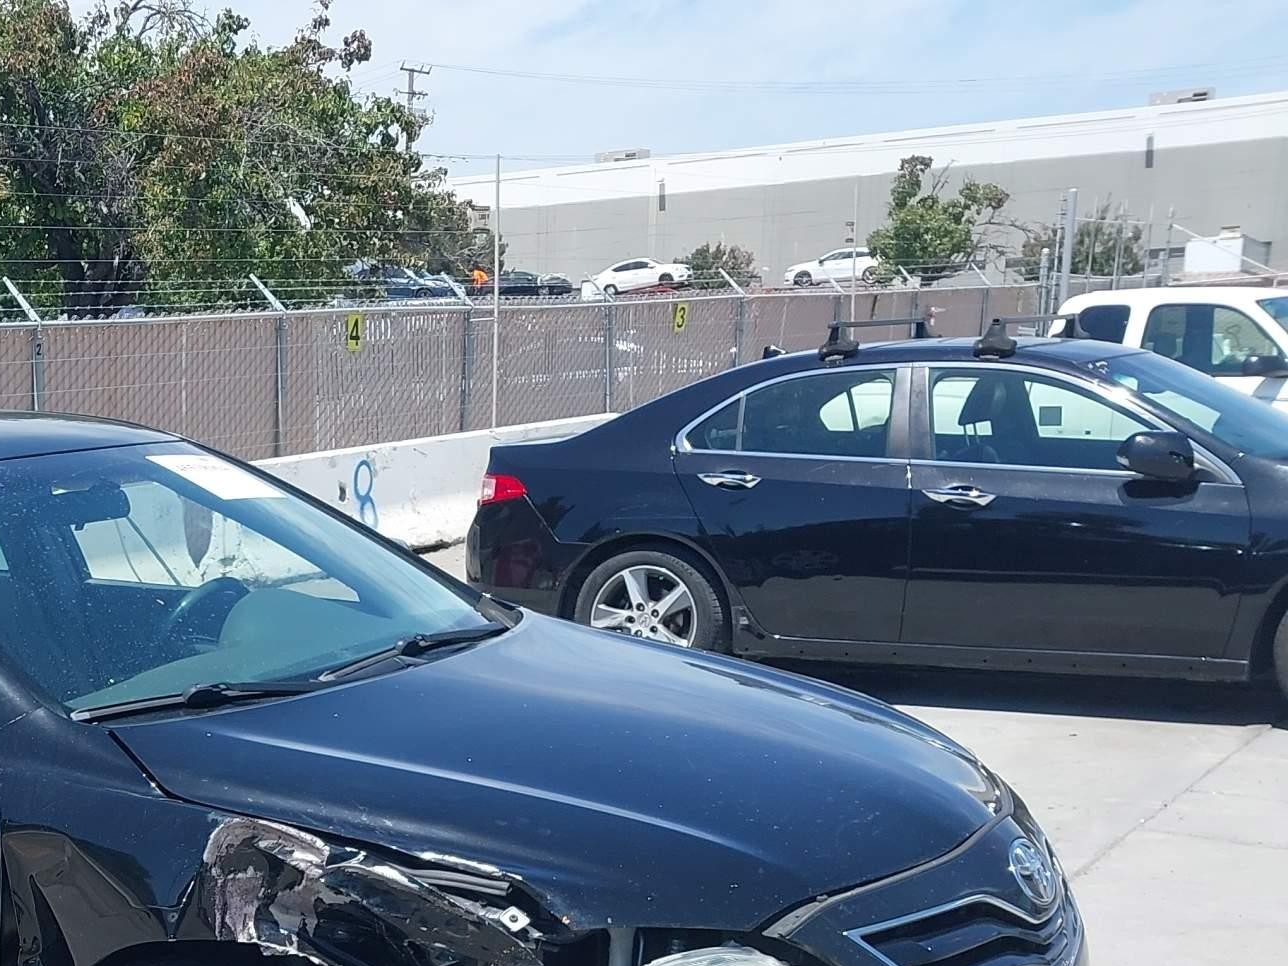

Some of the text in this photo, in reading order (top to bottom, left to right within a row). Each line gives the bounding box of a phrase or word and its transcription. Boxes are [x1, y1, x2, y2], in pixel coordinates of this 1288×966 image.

[676, 306, 686, 329] 3
[349, 317, 361, 346] 4
[36, 343, 42, 356] 2
